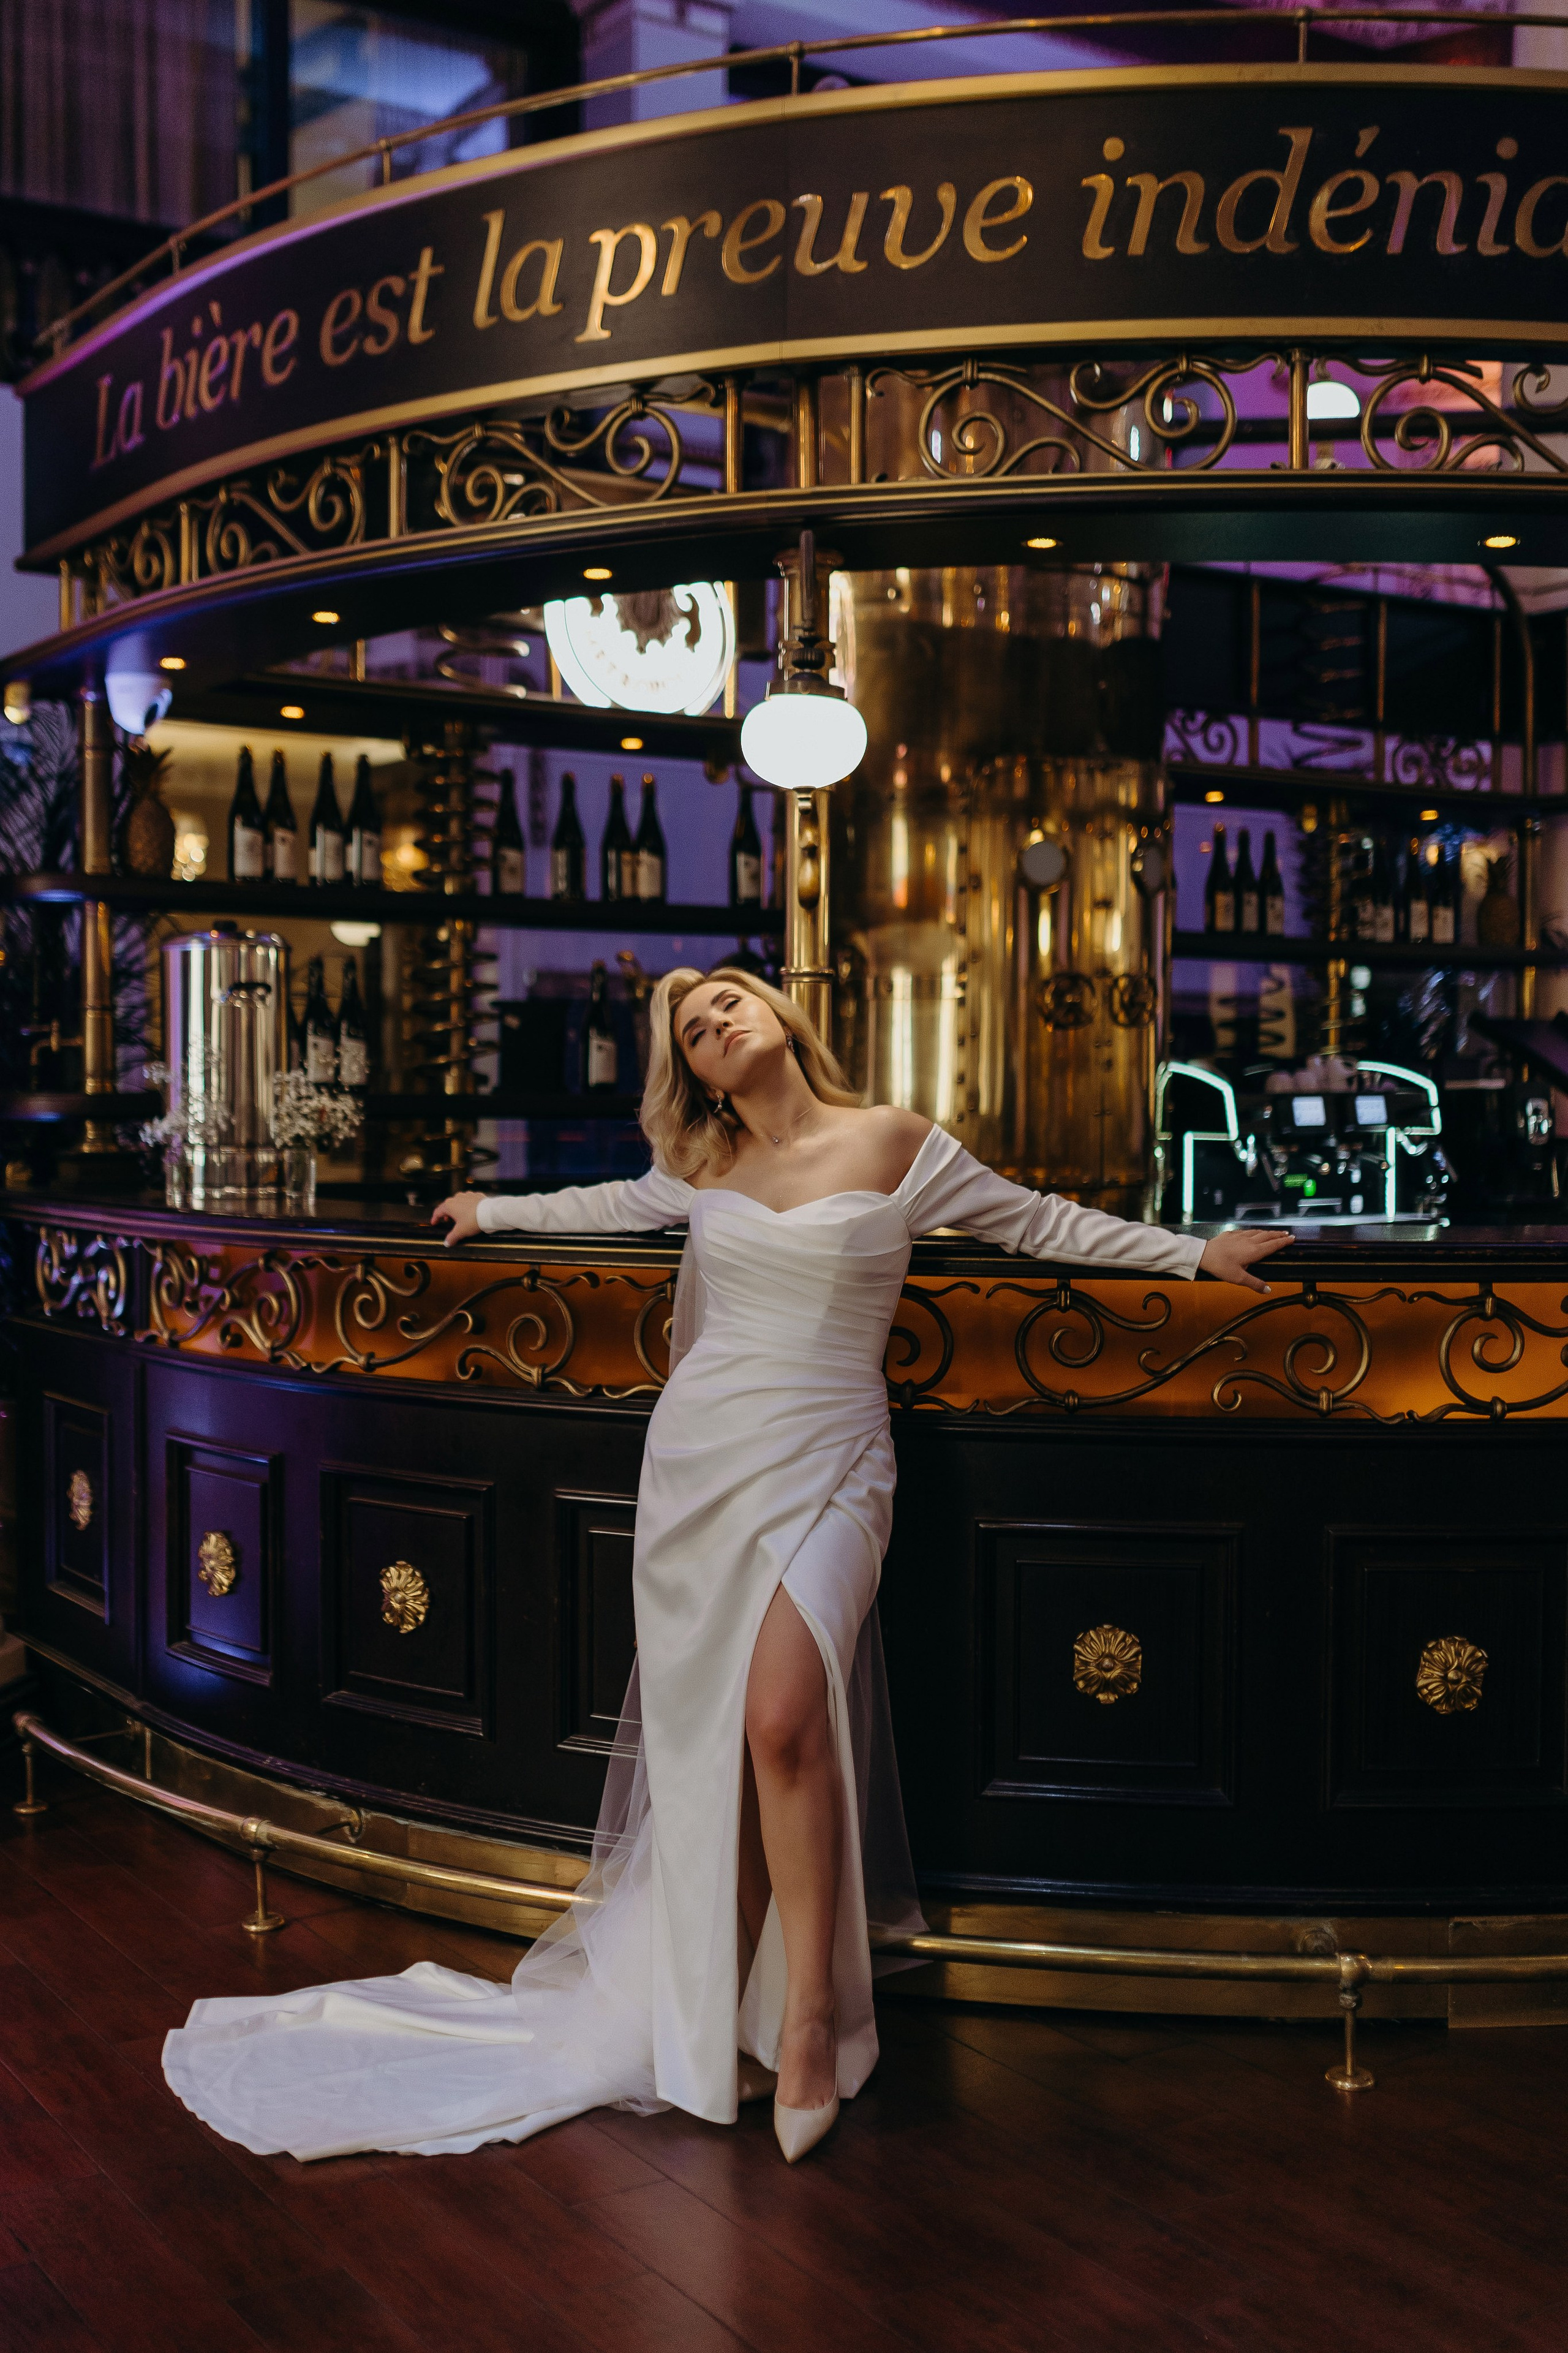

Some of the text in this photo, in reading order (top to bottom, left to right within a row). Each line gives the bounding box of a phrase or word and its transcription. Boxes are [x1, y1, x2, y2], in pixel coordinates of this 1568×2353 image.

[90, 374, 145, 470] La
[156, 301, 299, 430] bière
[319, 246, 445, 366] est
[472, 208, 564, 330] la
[573, 175, 1034, 343] preuve
